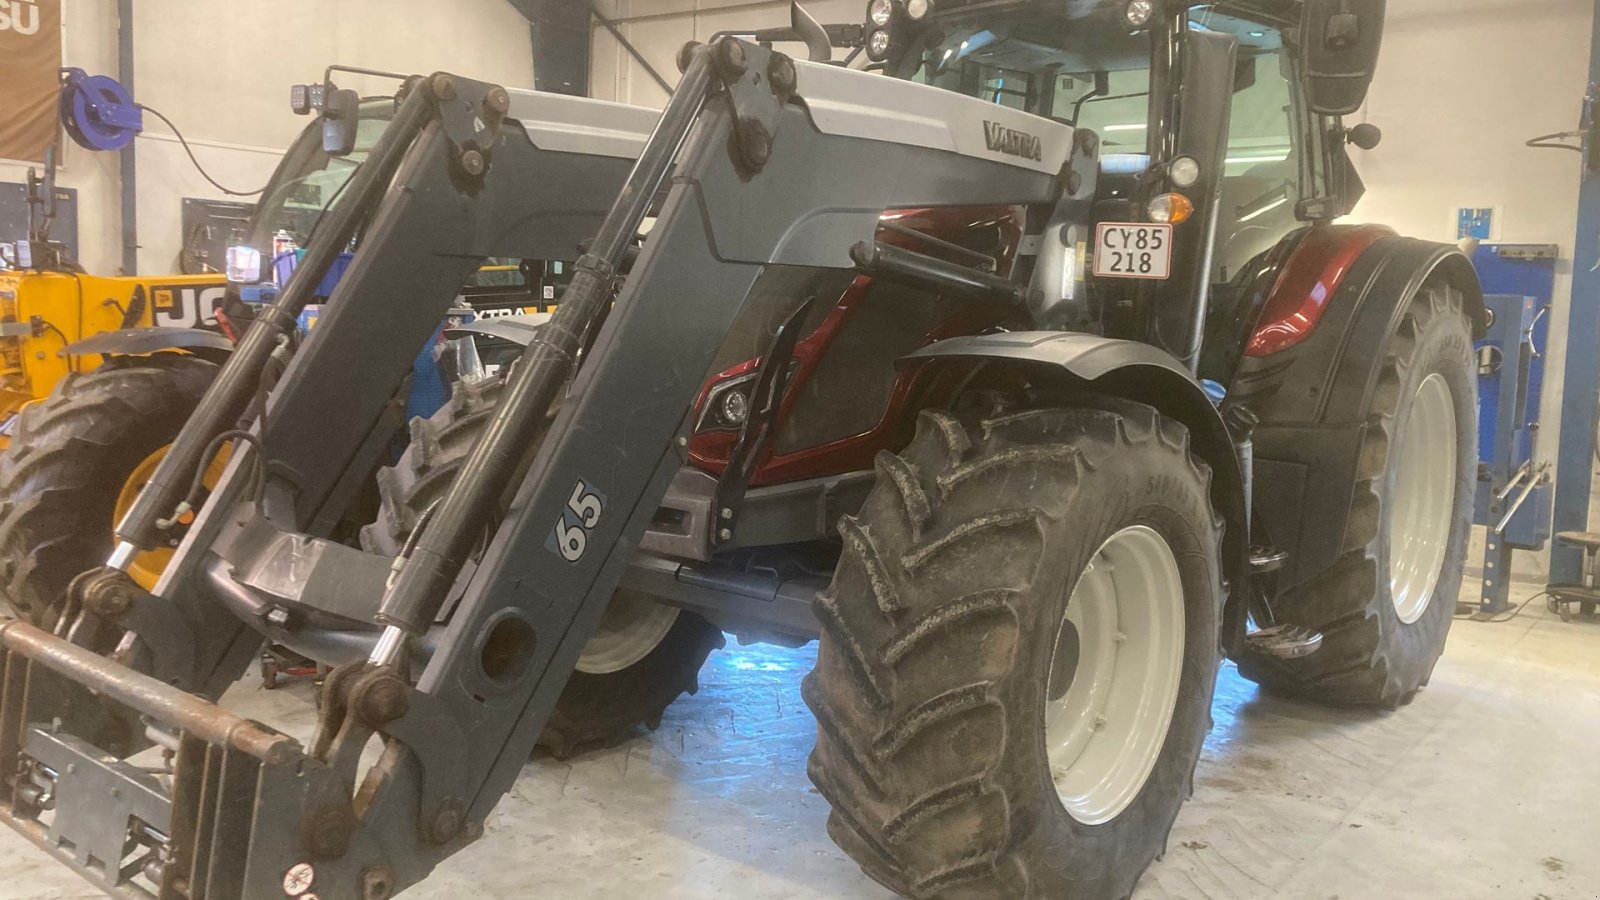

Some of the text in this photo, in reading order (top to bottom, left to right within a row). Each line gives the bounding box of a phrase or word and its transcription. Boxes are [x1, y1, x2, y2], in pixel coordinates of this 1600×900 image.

[983, 119, 1042, 162] VALTRA
[1103, 227, 1163, 250] CY85
[1110, 251, 1152, 273] 218
[554, 478, 603, 563] 65
